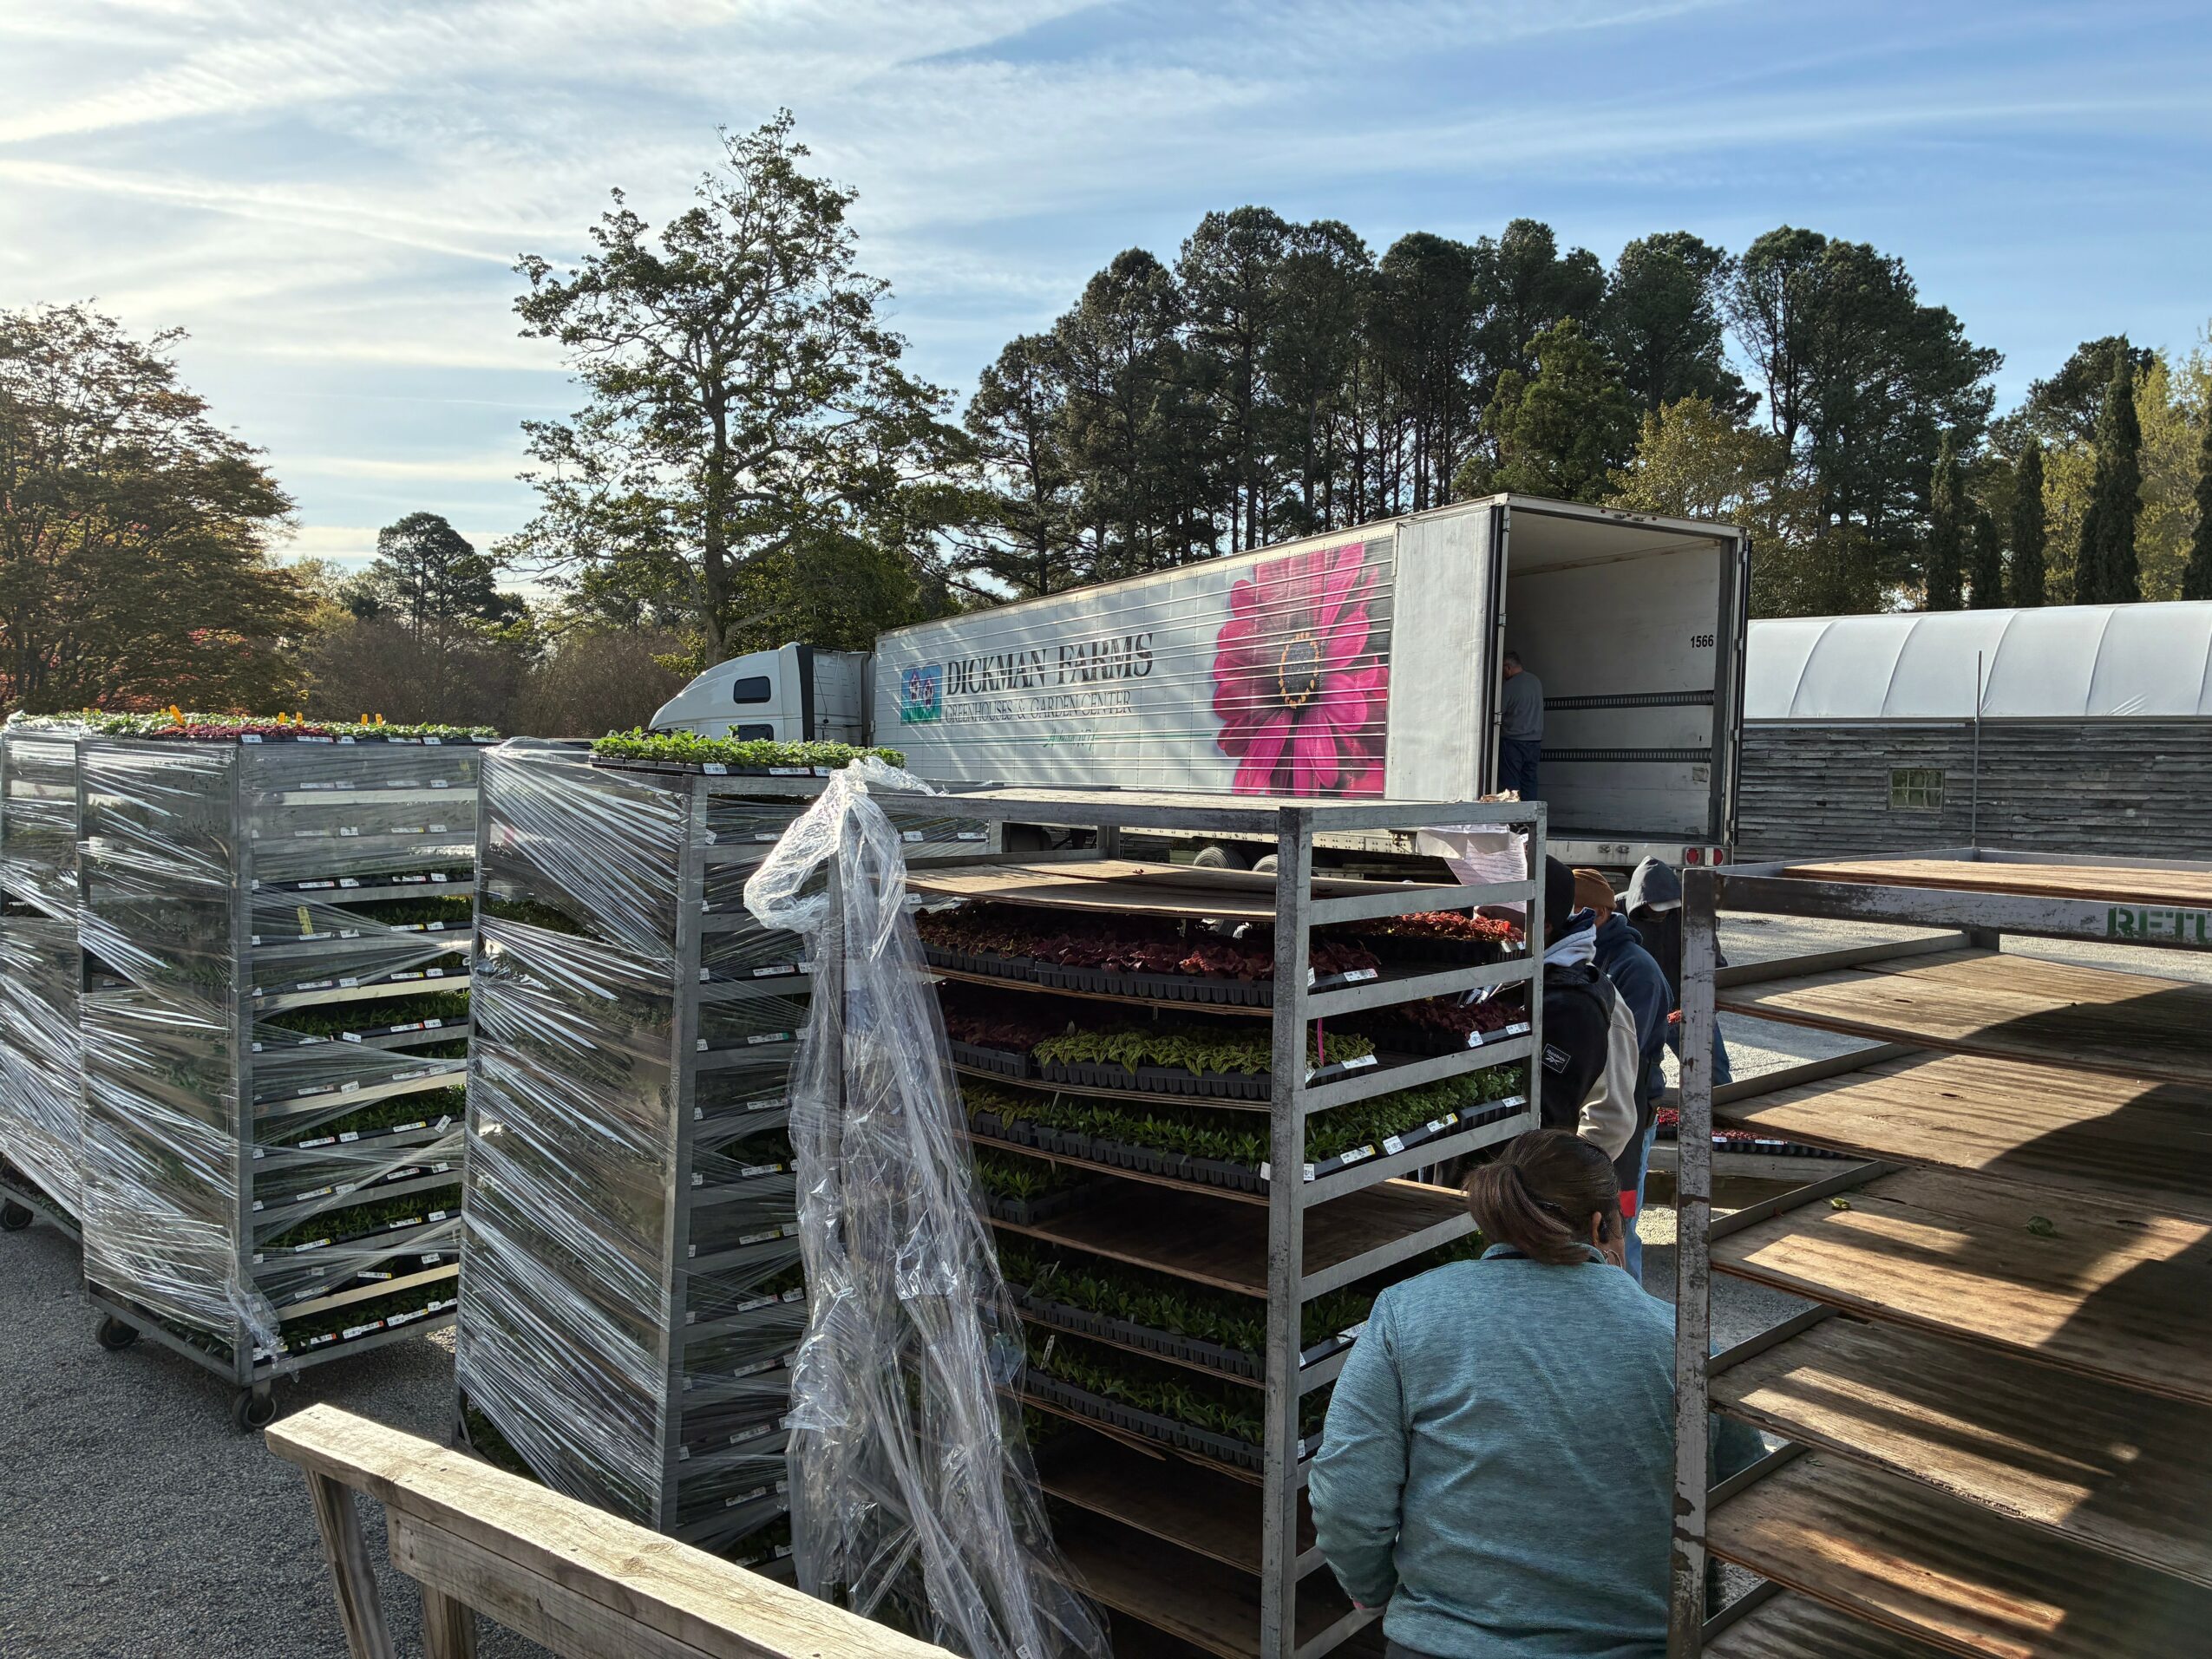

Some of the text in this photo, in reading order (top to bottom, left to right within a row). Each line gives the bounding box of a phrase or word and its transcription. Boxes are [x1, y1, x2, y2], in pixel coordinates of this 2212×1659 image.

[1690, 634, 1714, 649] 1566
[946, 632, 1154, 695] DICKMAN FARMS
[945, 690, 1133, 723] GREENHOUSES & GARDEN CENTER
